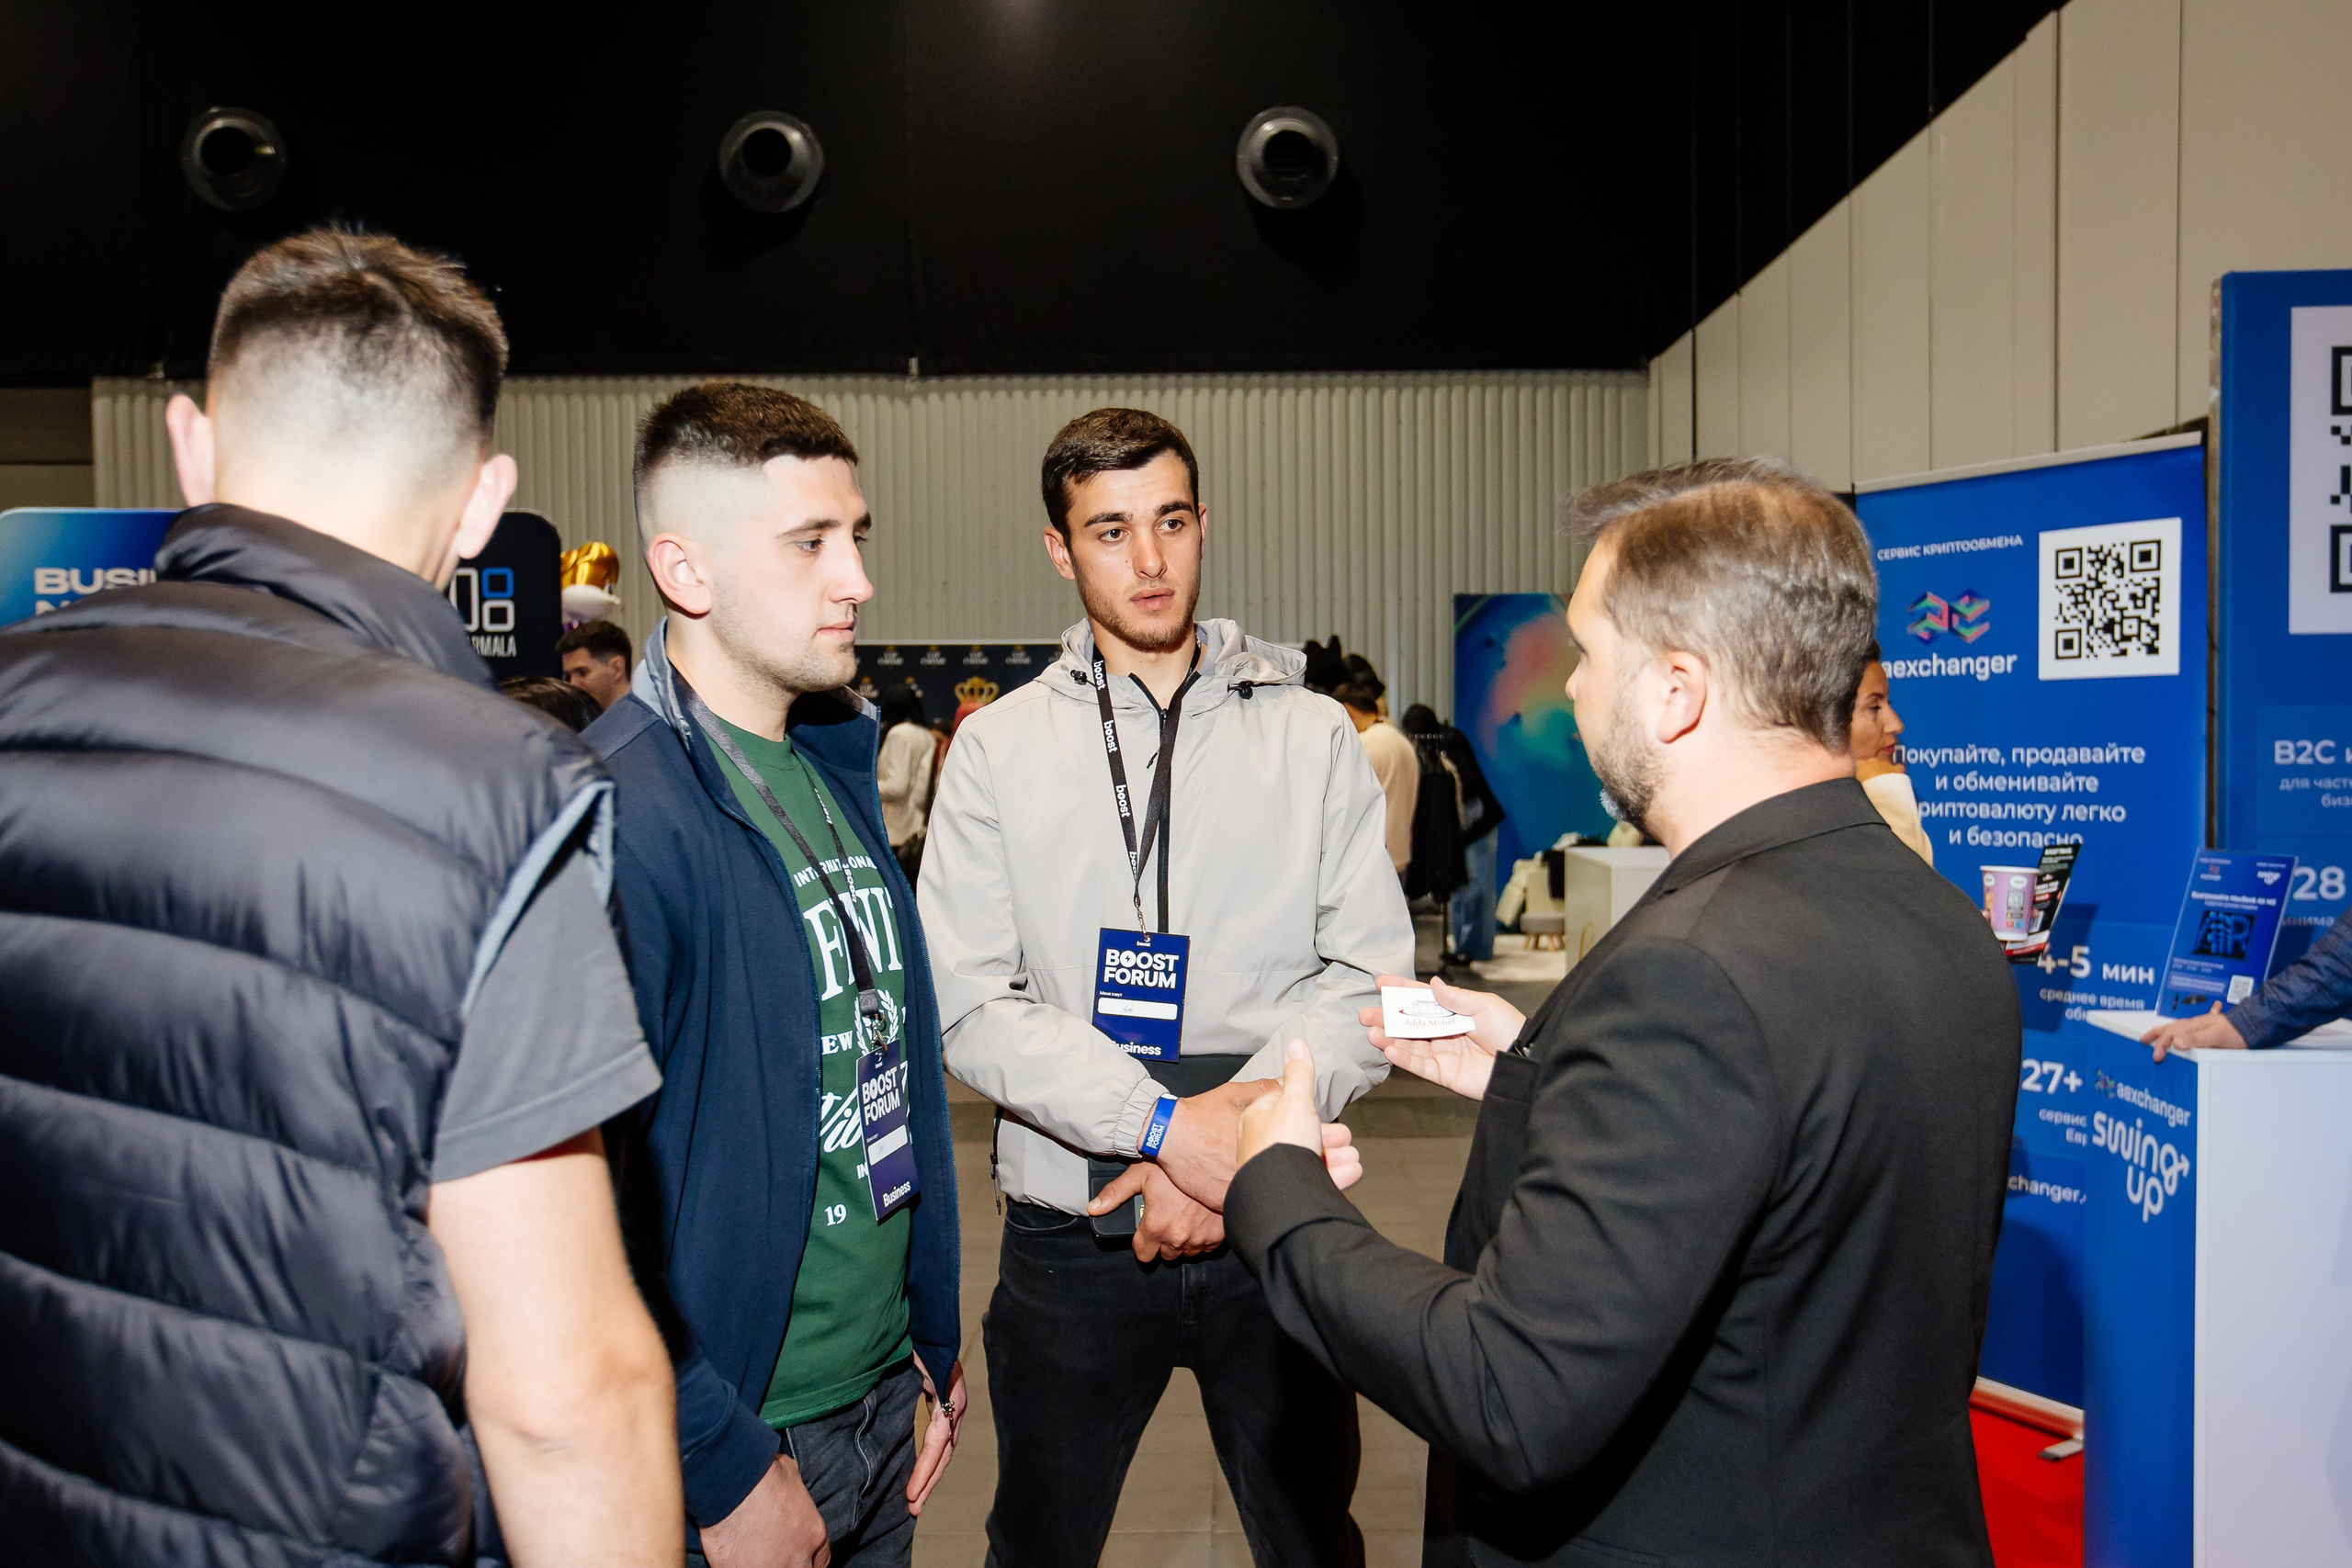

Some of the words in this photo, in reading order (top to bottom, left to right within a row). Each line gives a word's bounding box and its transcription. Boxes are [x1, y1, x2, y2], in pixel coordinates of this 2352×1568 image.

[1877, 545, 1921, 561] СЕРВИС
[1923, 534, 2024, 556] КРИПТООБМЕНА
[34, 567, 156, 594] BUSI
[1093, 660, 1105, 691] boost
[1103, 719, 1118, 753] boost
[1893, 743, 2006, 769] Покупайте,
[2011, 741, 2146, 769] продавайте
[2274, 739, 2336, 765] B2C
[1935, 775, 1948, 792] и
[1953, 770, 2100, 794] обменивайте
[1115, 784, 1131, 818] boost
[1917, 800, 2057, 826] риптовалюту
[2062, 803, 2128, 823] легко
[2321, 793, 2352, 808] биз
[1949, 829, 1962, 845] и
[1966, 825, 2085, 849] безопасно
[1105, 948, 1180, 972] BOOST
[1103, 966, 1177, 989] FORUM
[2102, 962, 2155, 986] мин
[2039, 987, 2098, 1005] среднее
[2099, 994, 2146, 1010] время
[821, 1030, 854, 1055] EW
[1113, 1041, 1162, 1055] usiness
[862, 1066, 898, 1104] BOOST
[2021, 1057, 2084, 1095] 27+
[864, 1089, 900, 1126] FORUM
[2117, 1081, 2191, 1128] aexchanger
[1146, 1122, 1159, 1147] BOOST
[1151, 1124, 1165, 1149] FORUM
[882, 1180, 911, 1208] Business
[2007, 1174, 2087, 1205] changer.
[824, 1204, 847, 1226] 19
